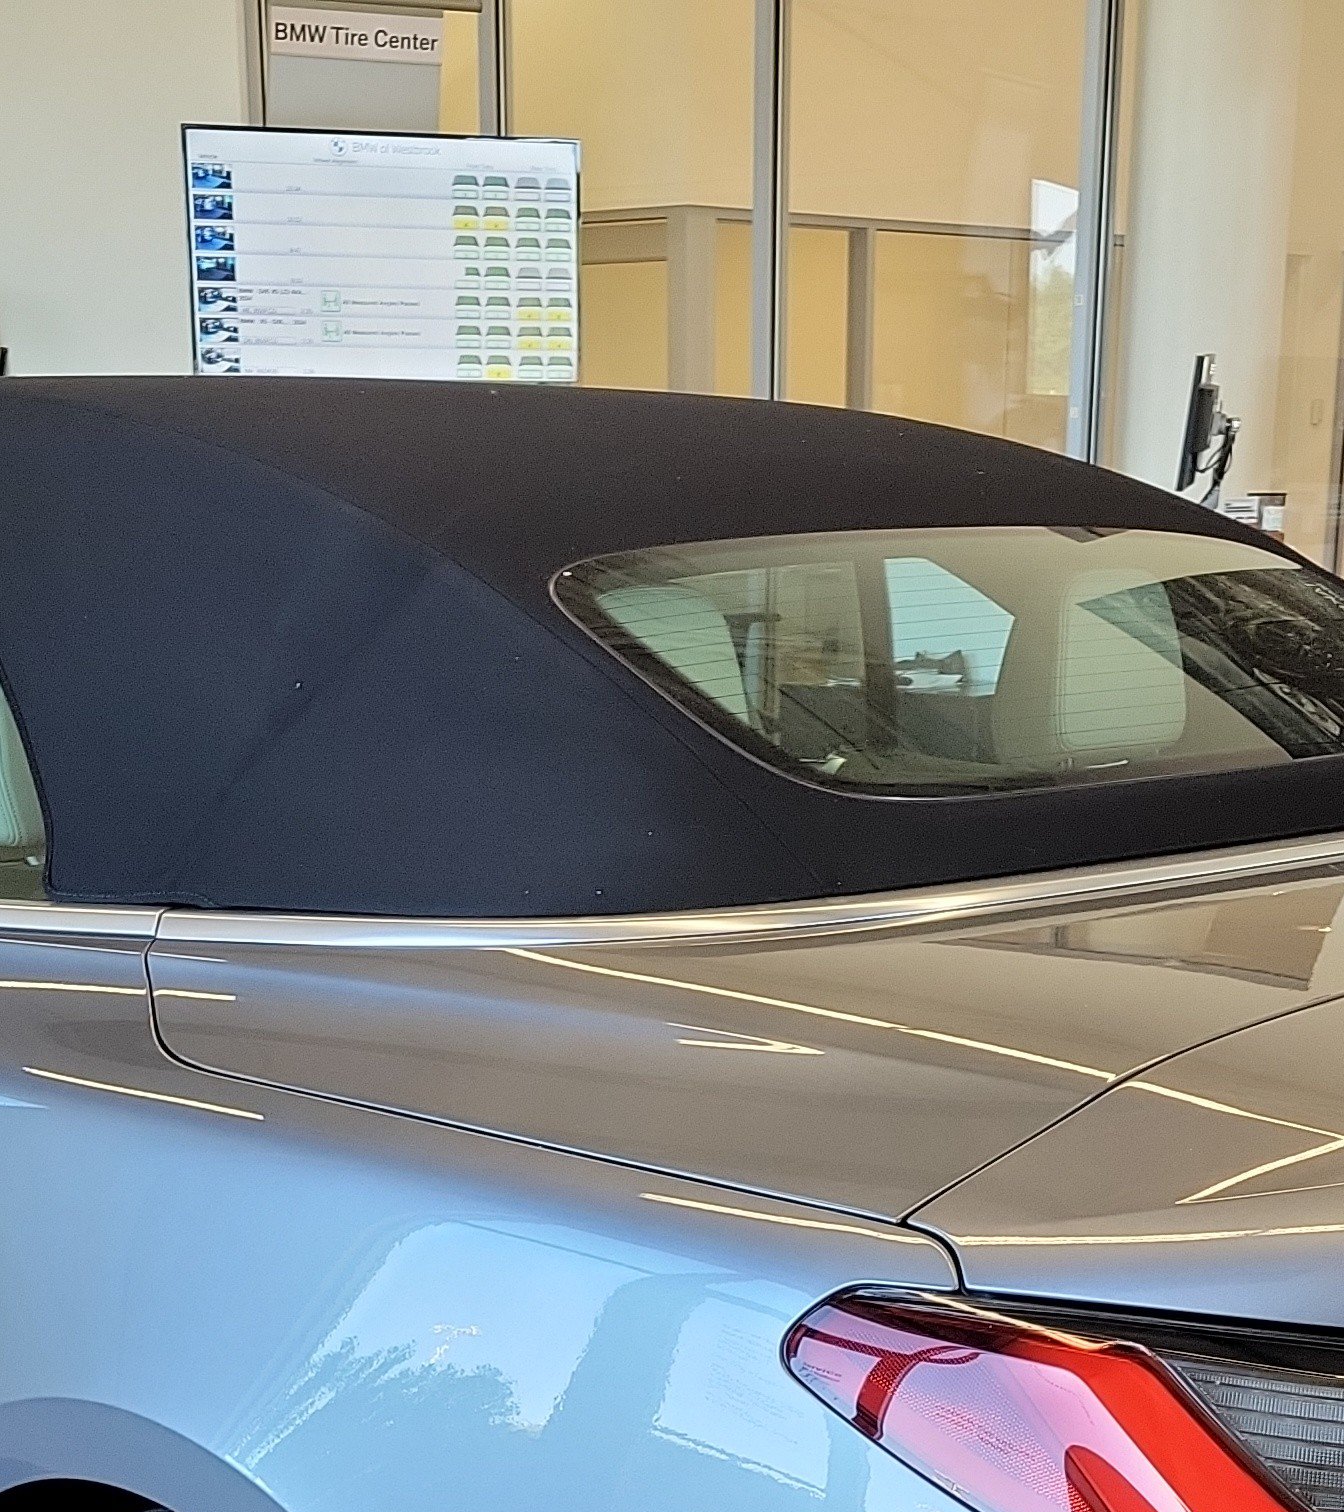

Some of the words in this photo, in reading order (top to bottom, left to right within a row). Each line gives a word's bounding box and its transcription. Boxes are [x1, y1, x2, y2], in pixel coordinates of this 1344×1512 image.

[274, 22, 326, 44] BMW
[330, 26, 369, 47] Tire
[374, 29, 439, 51] Center
